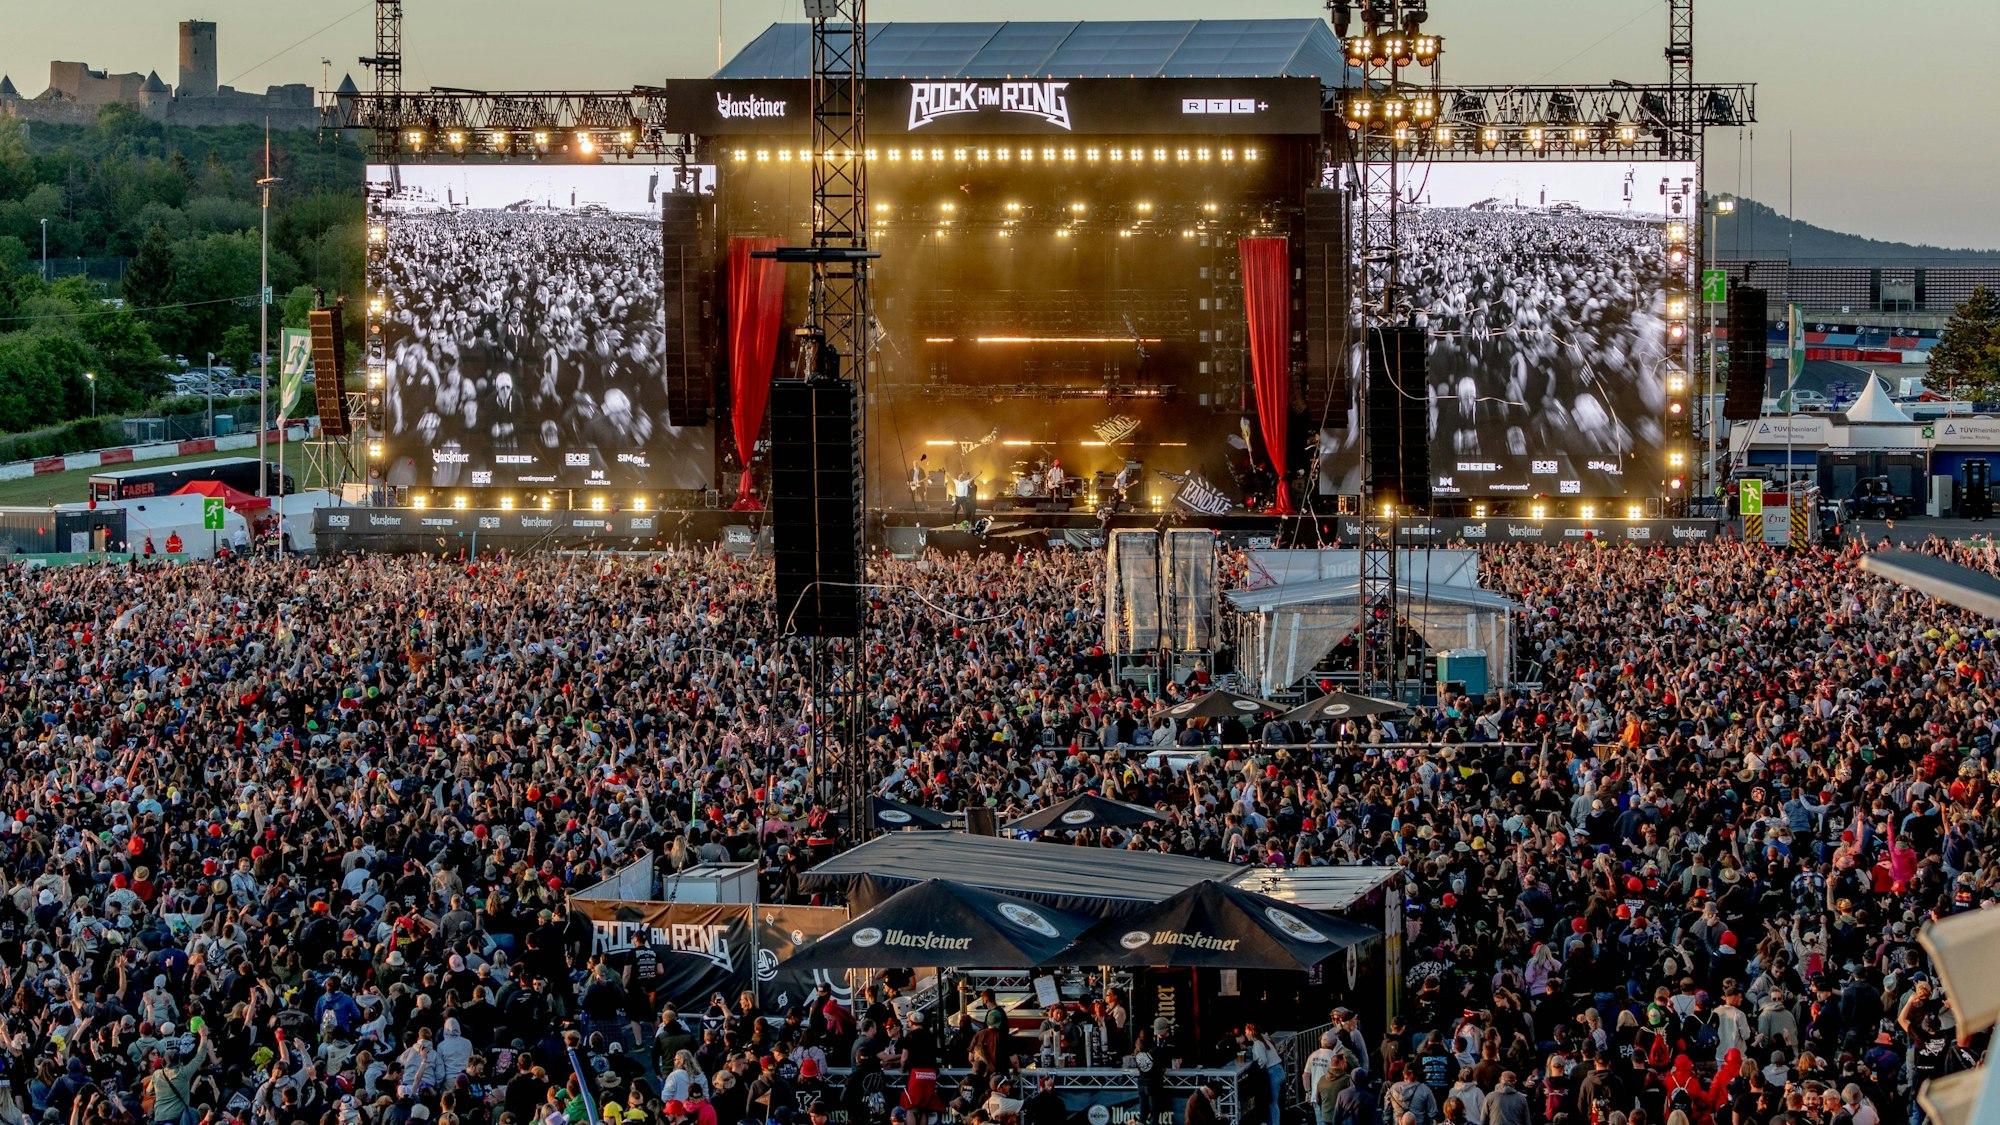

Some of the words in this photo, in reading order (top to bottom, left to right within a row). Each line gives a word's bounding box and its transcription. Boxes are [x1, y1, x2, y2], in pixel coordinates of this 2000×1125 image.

[908, 83, 978, 130] ROCK
[978, 87, 1000, 106] AM
[1000, 83, 1071, 130] RING
[122, 482, 155, 496] FABER
[1182, 478, 1233, 516] RANDALE
[651, 927, 670, 946] AM
[671, 923, 734, 974] RING
[884, 928, 973, 951] Warsteiner
[1152, 929, 1240, 952] Warsteiner
